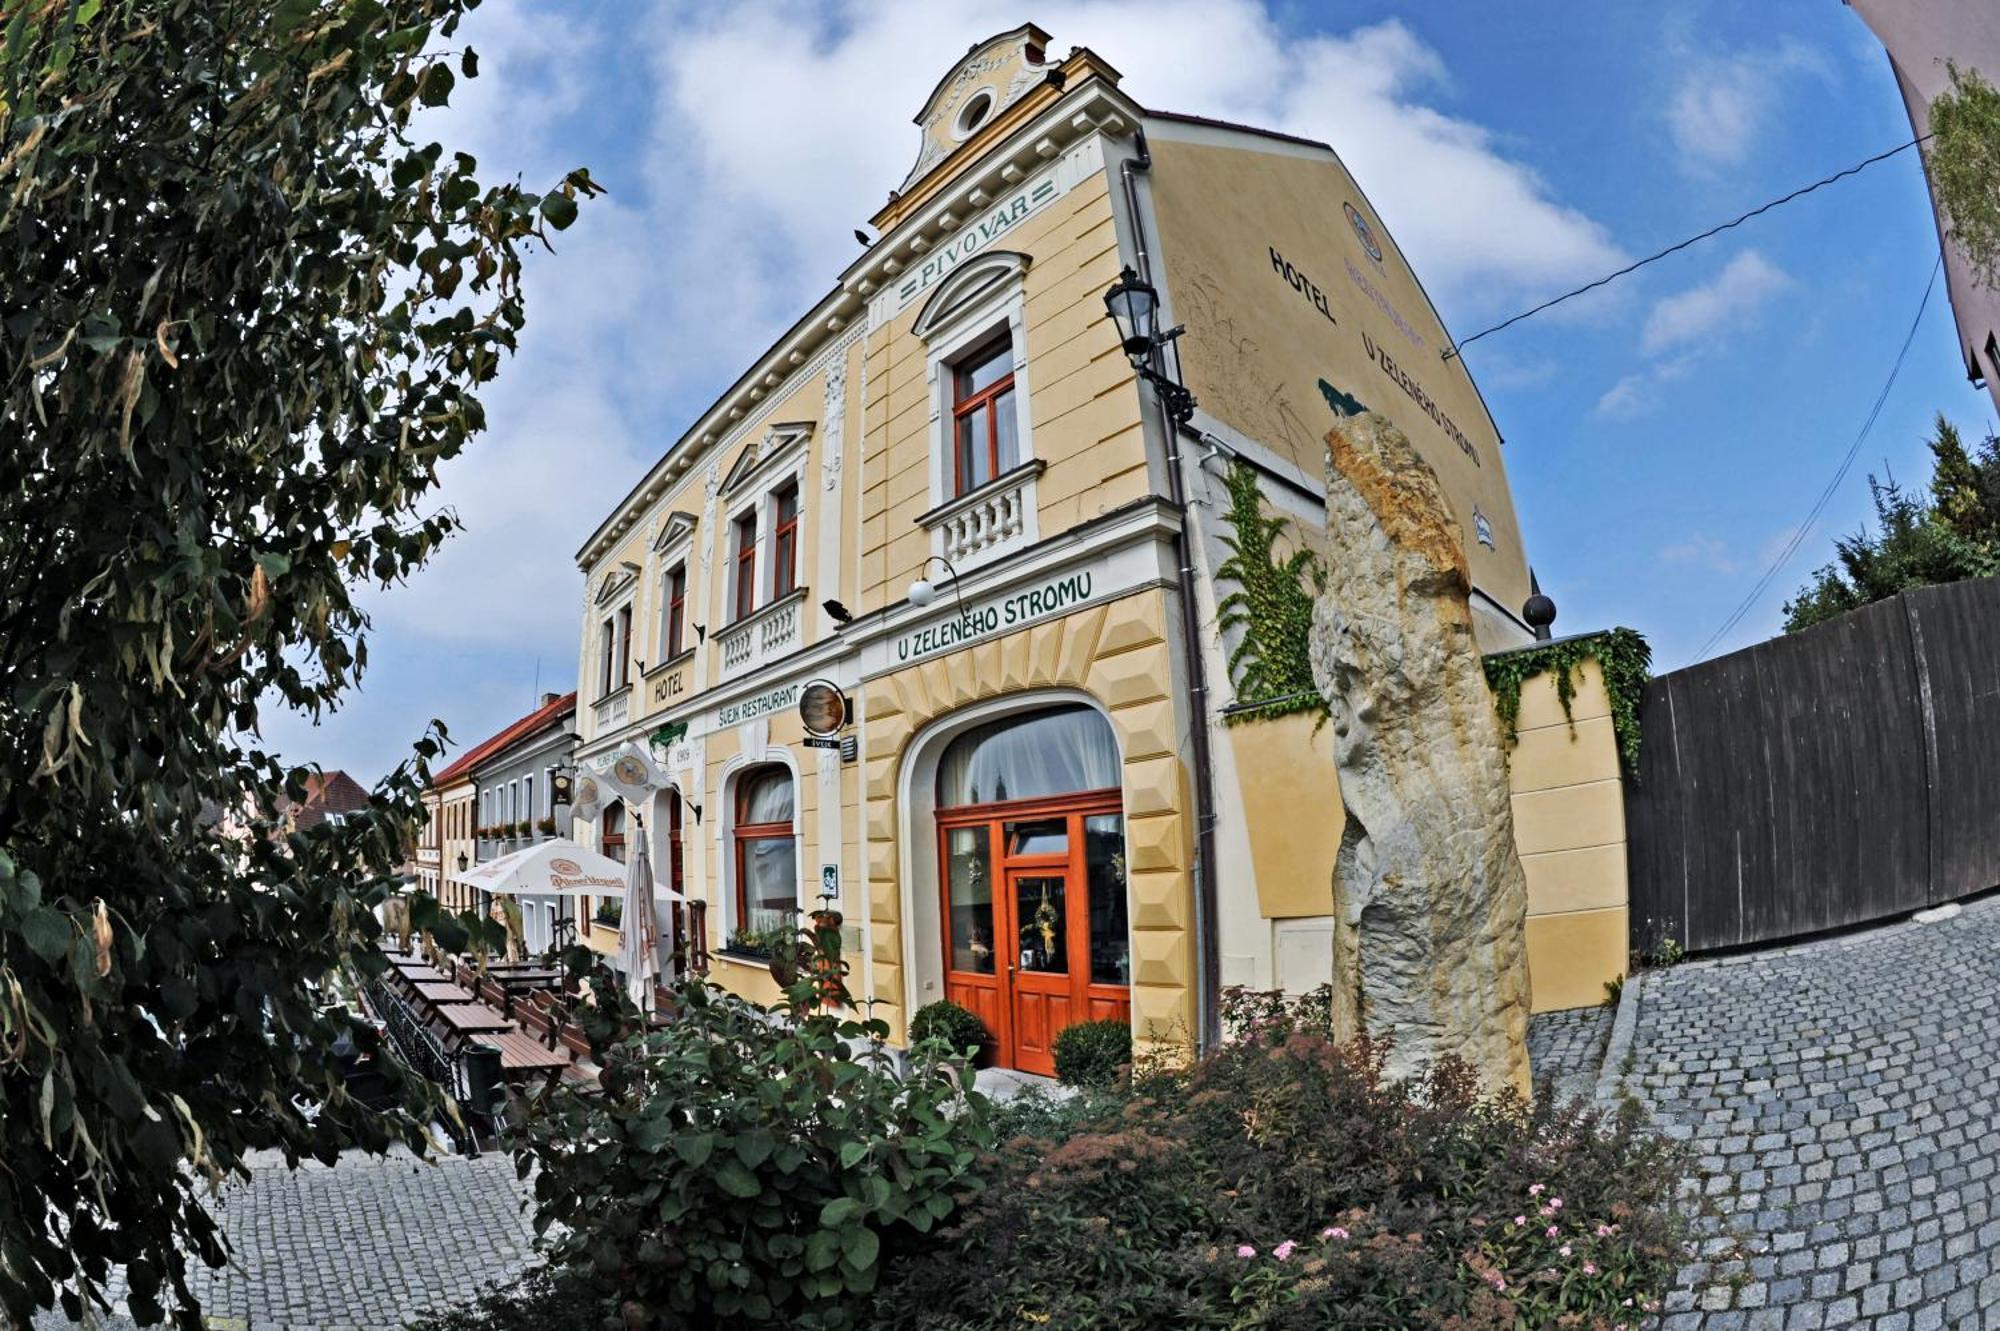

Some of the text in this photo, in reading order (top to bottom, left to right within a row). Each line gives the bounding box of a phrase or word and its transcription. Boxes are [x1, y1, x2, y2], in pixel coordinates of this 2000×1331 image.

[921, 196, 1029, 287] PIVOVAR
[1268, 246, 1337, 326] HOTEL
[1362, 331, 1375, 361] U
[898, 638, 908, 660] U
[1004, 571, 1092, 625] STROMU
[655, 671, 684, 703] HOTEL
[742, 684, 798, 720] RESTAURANT
